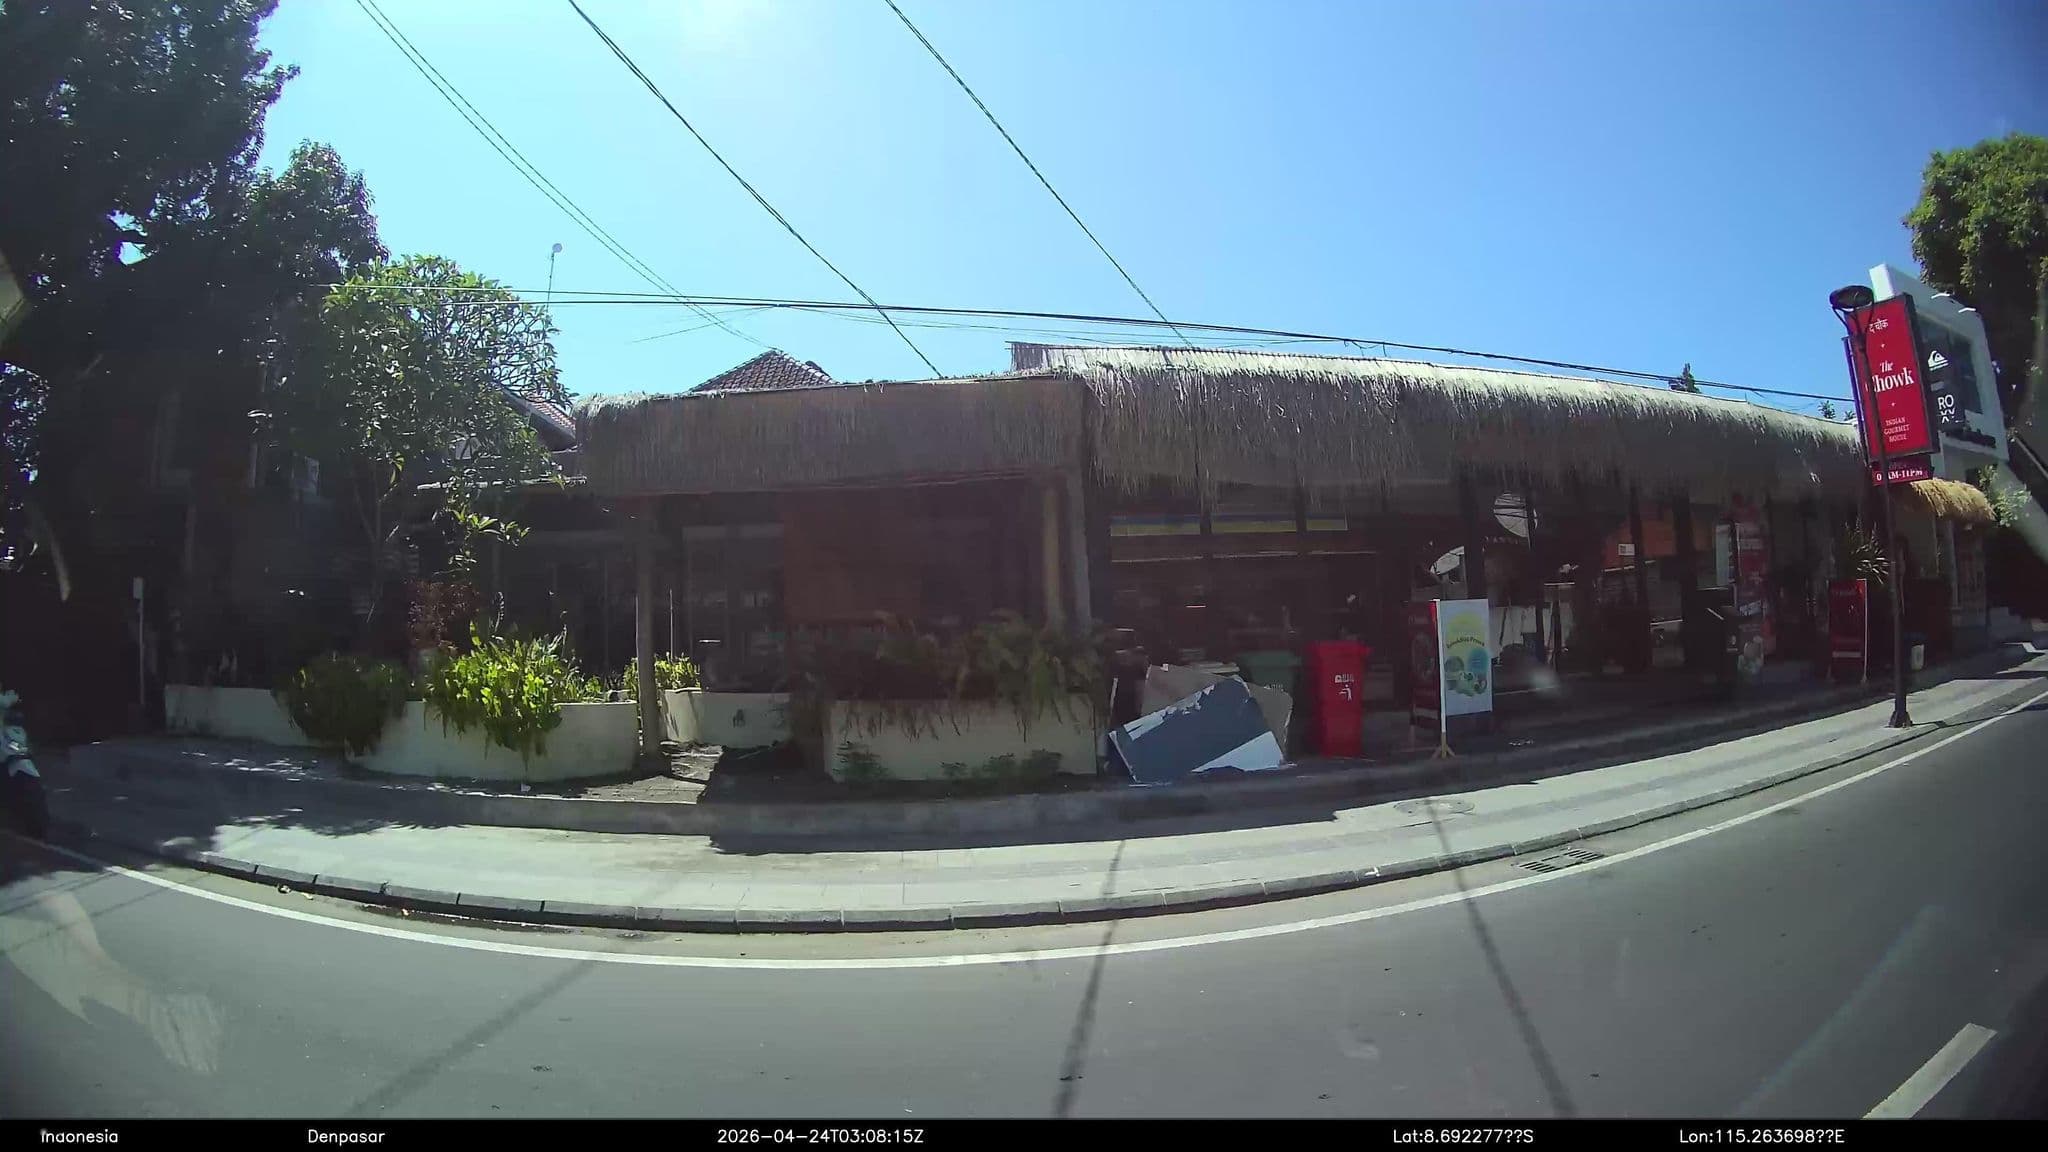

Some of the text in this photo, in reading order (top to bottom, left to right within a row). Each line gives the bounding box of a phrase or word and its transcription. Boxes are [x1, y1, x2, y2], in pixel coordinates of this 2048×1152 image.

[1880, 360, 1893, 373] The
[1885, 416, 1906, 426] INDIAN
[1883, 424, 1910, 435] GOURMET
